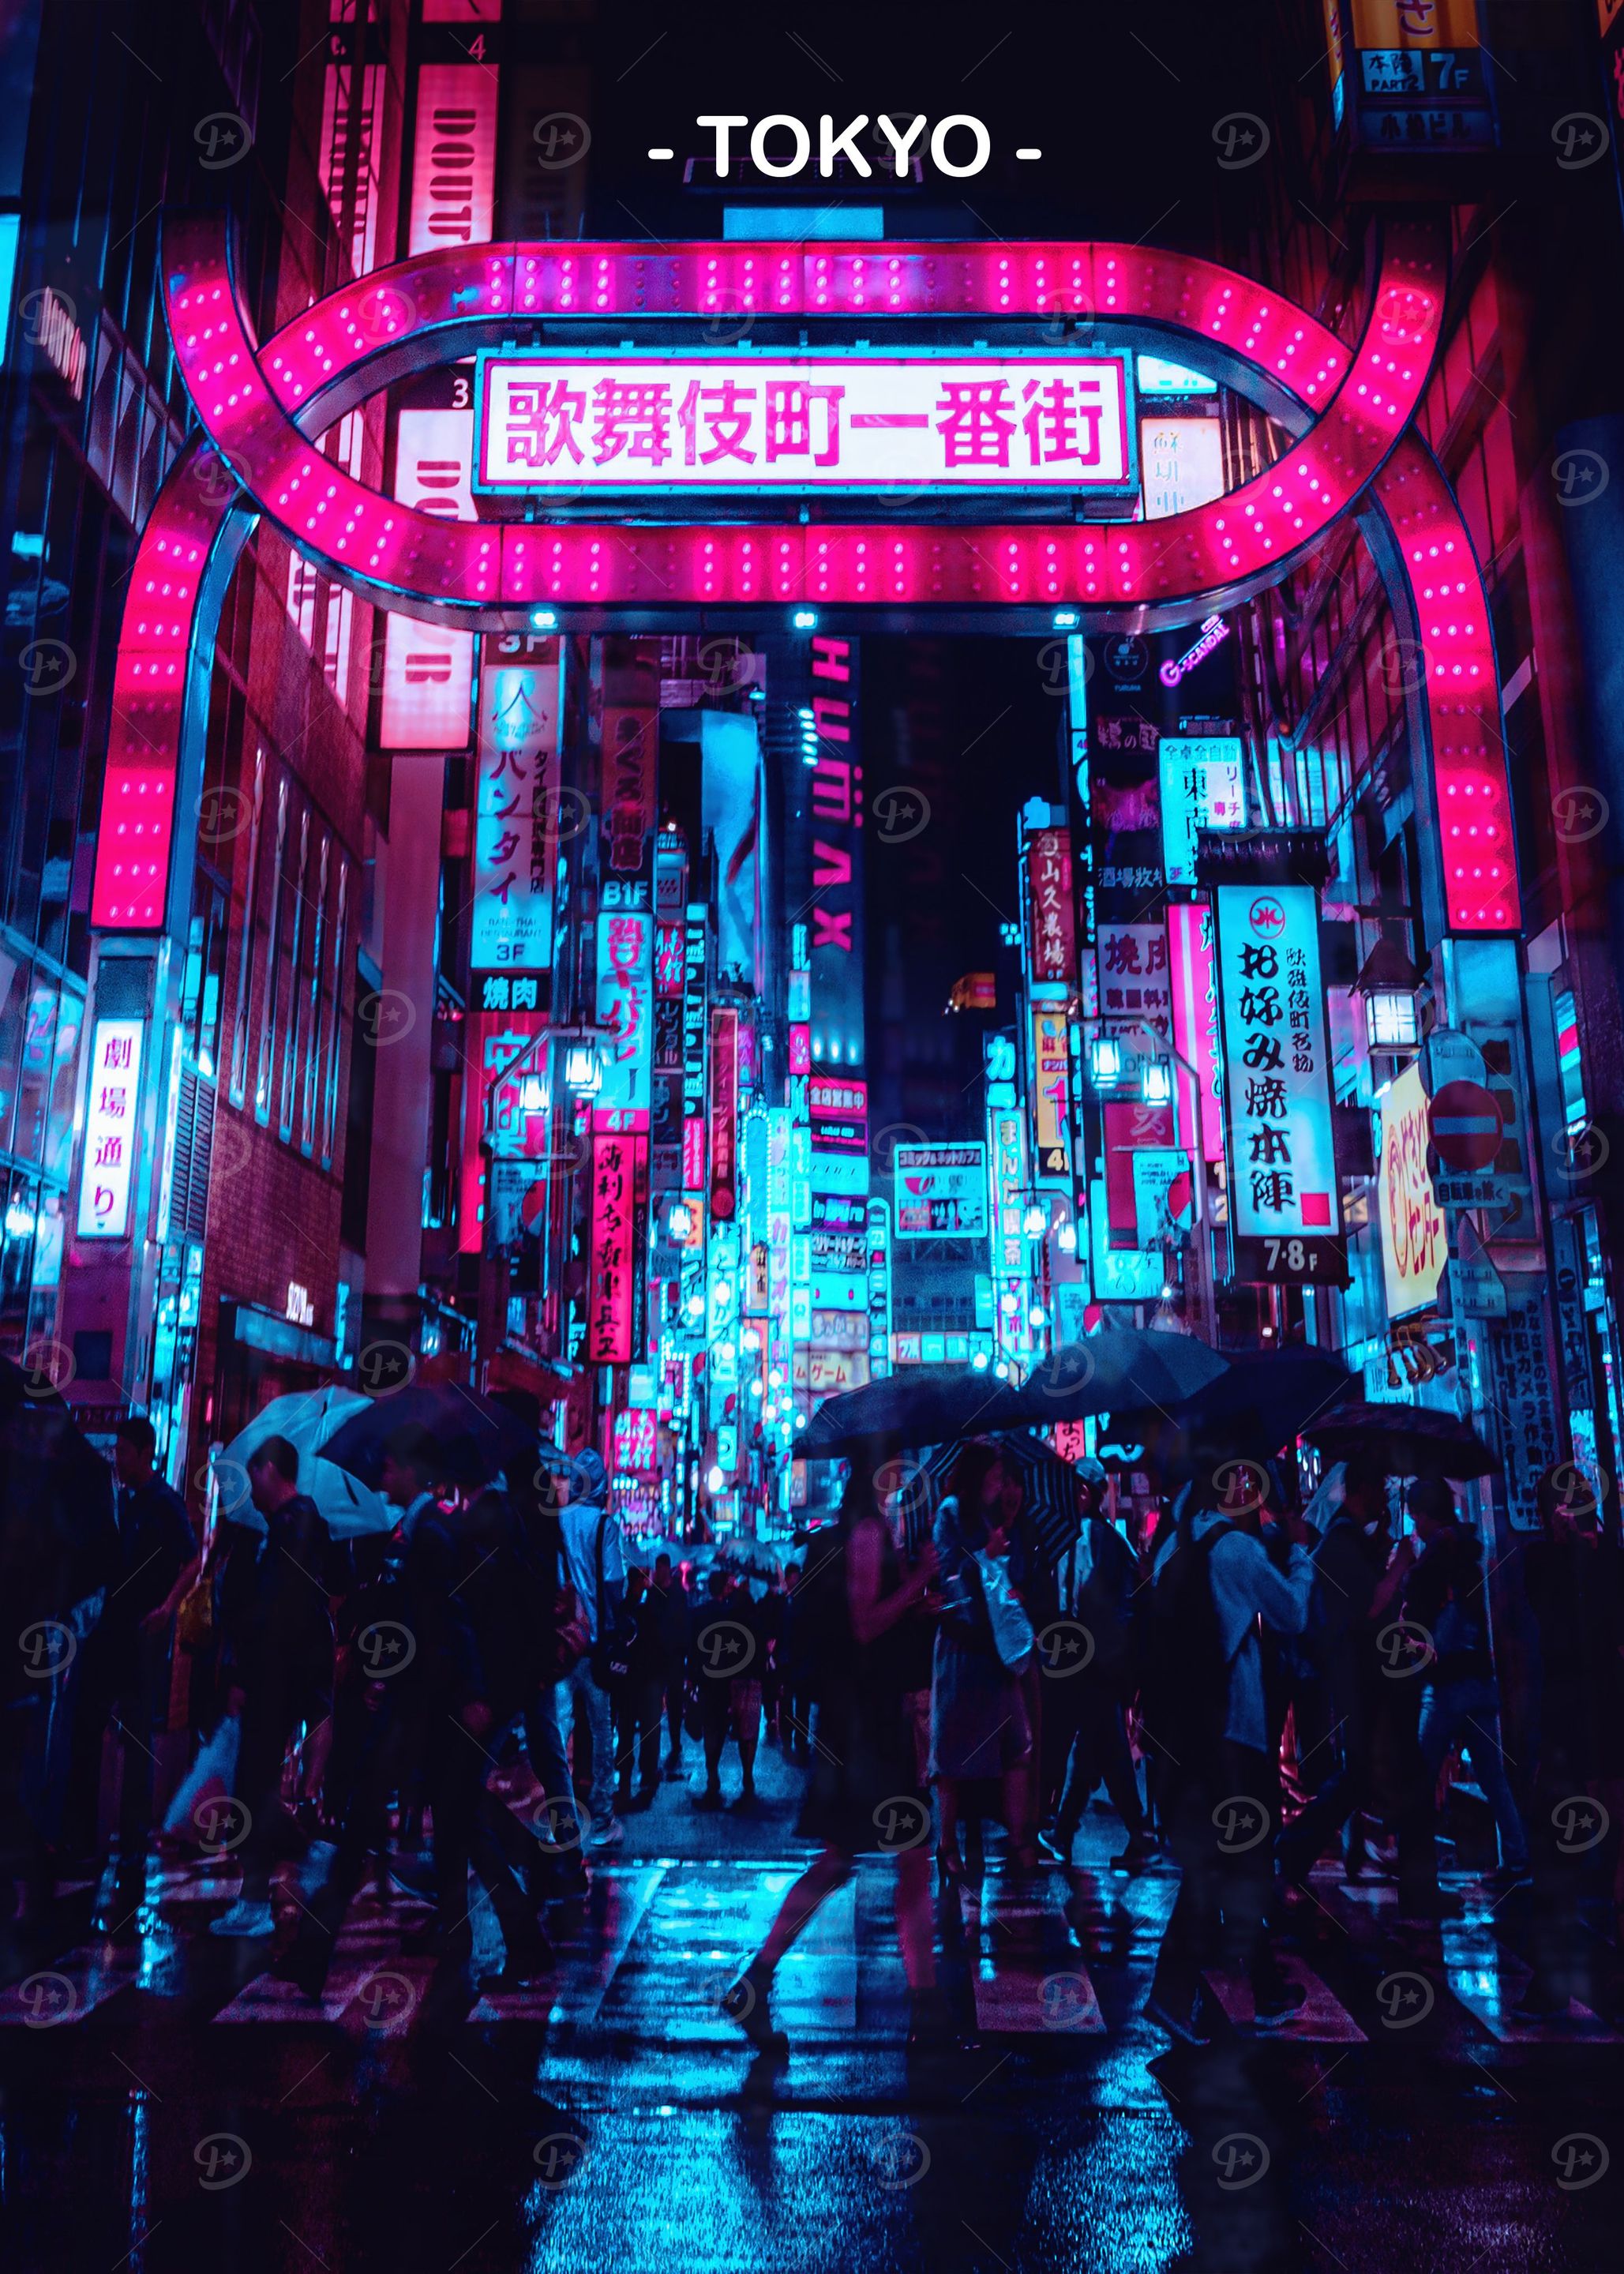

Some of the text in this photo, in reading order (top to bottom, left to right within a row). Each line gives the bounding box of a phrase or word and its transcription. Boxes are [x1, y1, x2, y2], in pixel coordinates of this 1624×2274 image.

[468, 34, 486, 60] 4
[1371, 76, 1420, 91] PART2
[1430, 52, 1470, 89] 7F
[452, 378, 469, 409] 3
[505, 377, 1103, 467] 歌舞伎町一番街
[489, 751, 527, 904] バンタイ
[602, 880, 648, 906] B1F
[497, 943, 525, 962] 3F
[483, 976, 538, 1010] 焼肉
[1237, 942, 1297, 1214] お好み焼本陣
[94, 1035, 133, 1216] 劇場通り
[606, 1109, 636, 1131] 4F
[812, 1364, 847, 1383] ゲーム
